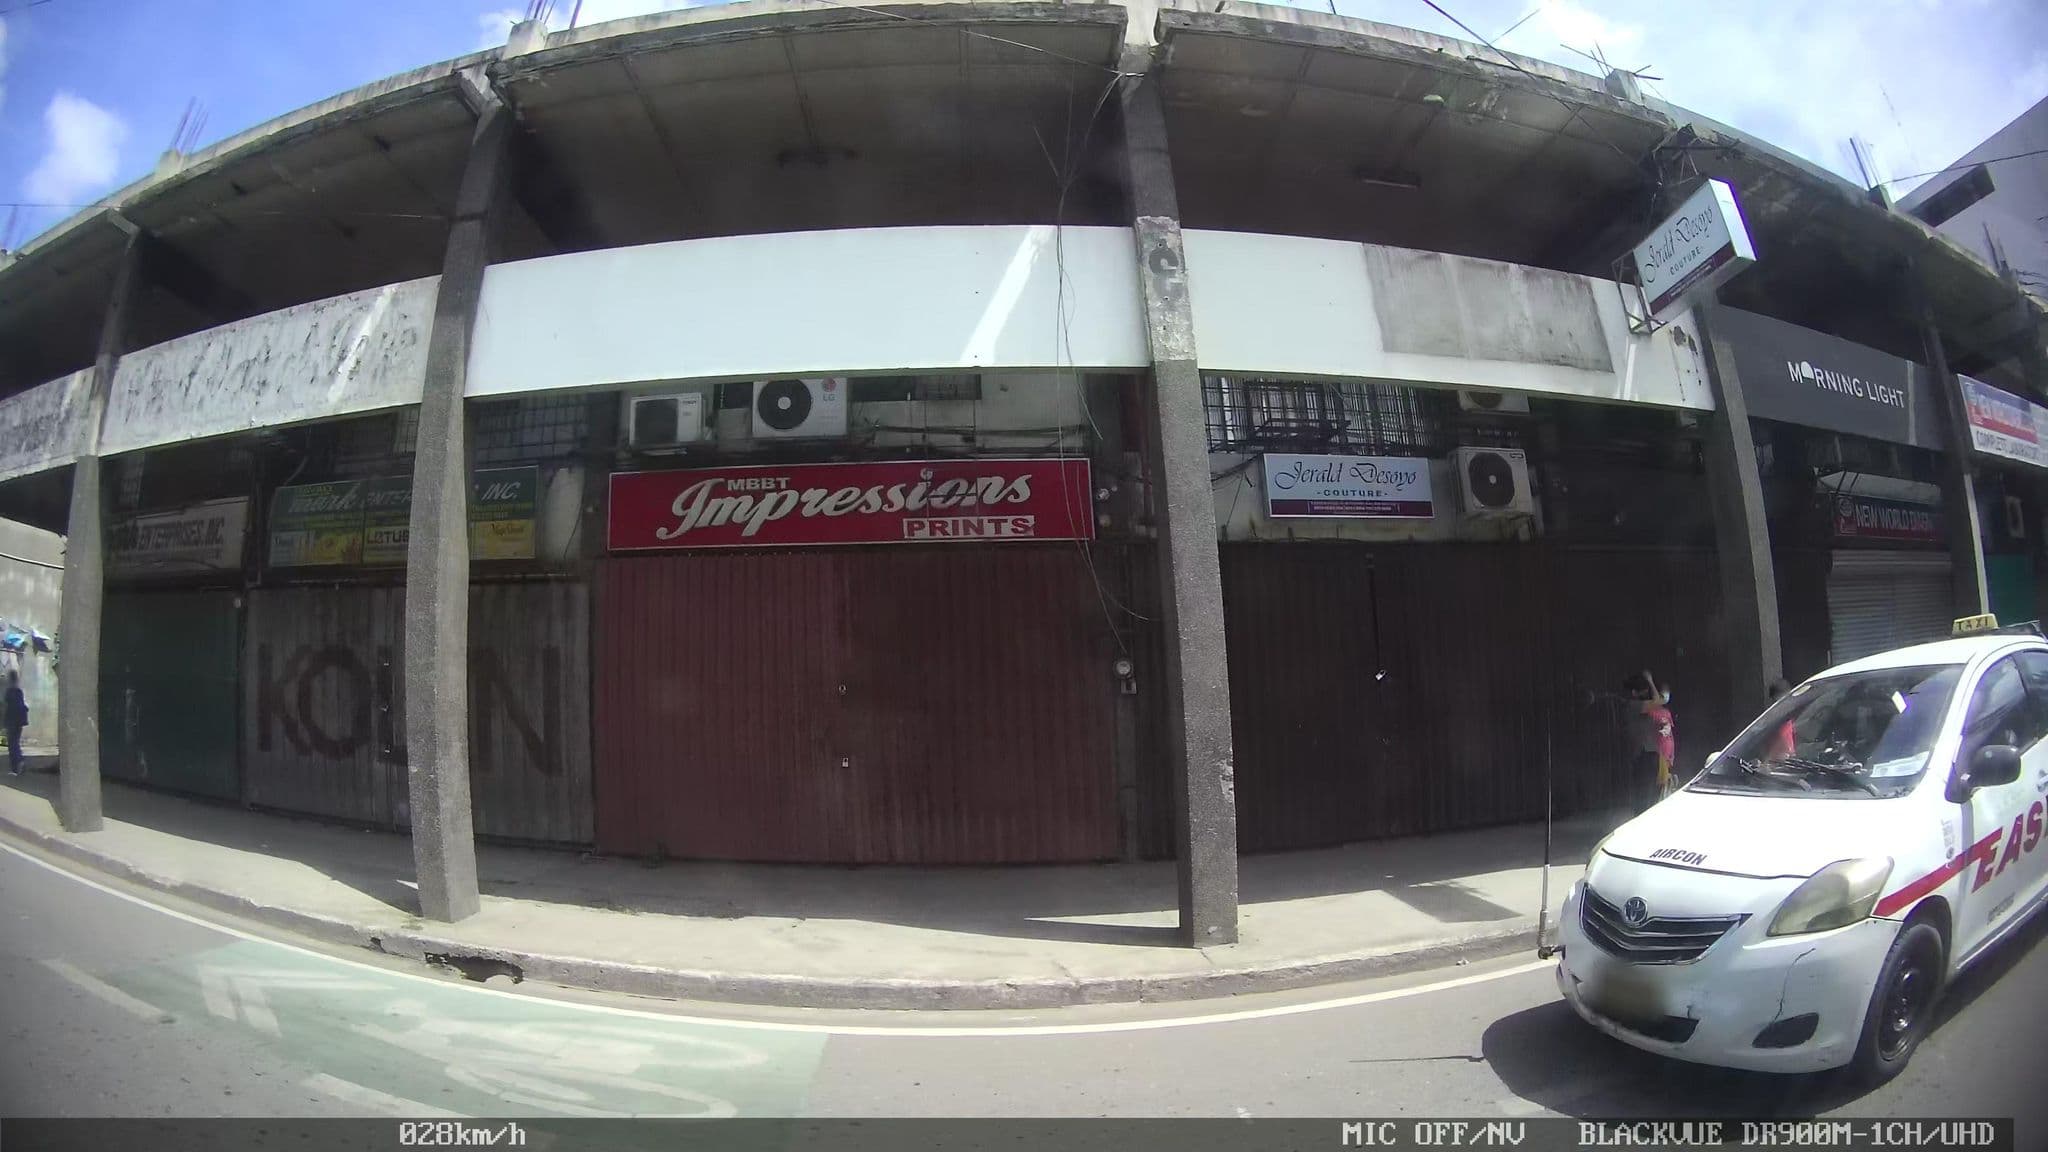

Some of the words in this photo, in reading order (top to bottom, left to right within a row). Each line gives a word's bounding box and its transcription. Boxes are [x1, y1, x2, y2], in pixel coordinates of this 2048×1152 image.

[1787, 359, 1864, 399] MORNING
[1865, 380, 1905, 409] LIGHT
[726, 476, 792, 492] MBBT
[1274, 461, 1343, 490] Jerald
[1349, 462, 1417, 492] Desoyo
[480, 481, 521, 501] INC.
[656, 467, 1033, 541] Impressions
[906, 517, 1033, 538] PRINTS
[1855, 503, 1878, 529] NEW
[1956, 616, 1989, 631] TAXI
[256, 643, 563, 777] KOLN
[1649, 848, 1708, 866] AIRCON
[1971, 794, 2048, 894] EAS
